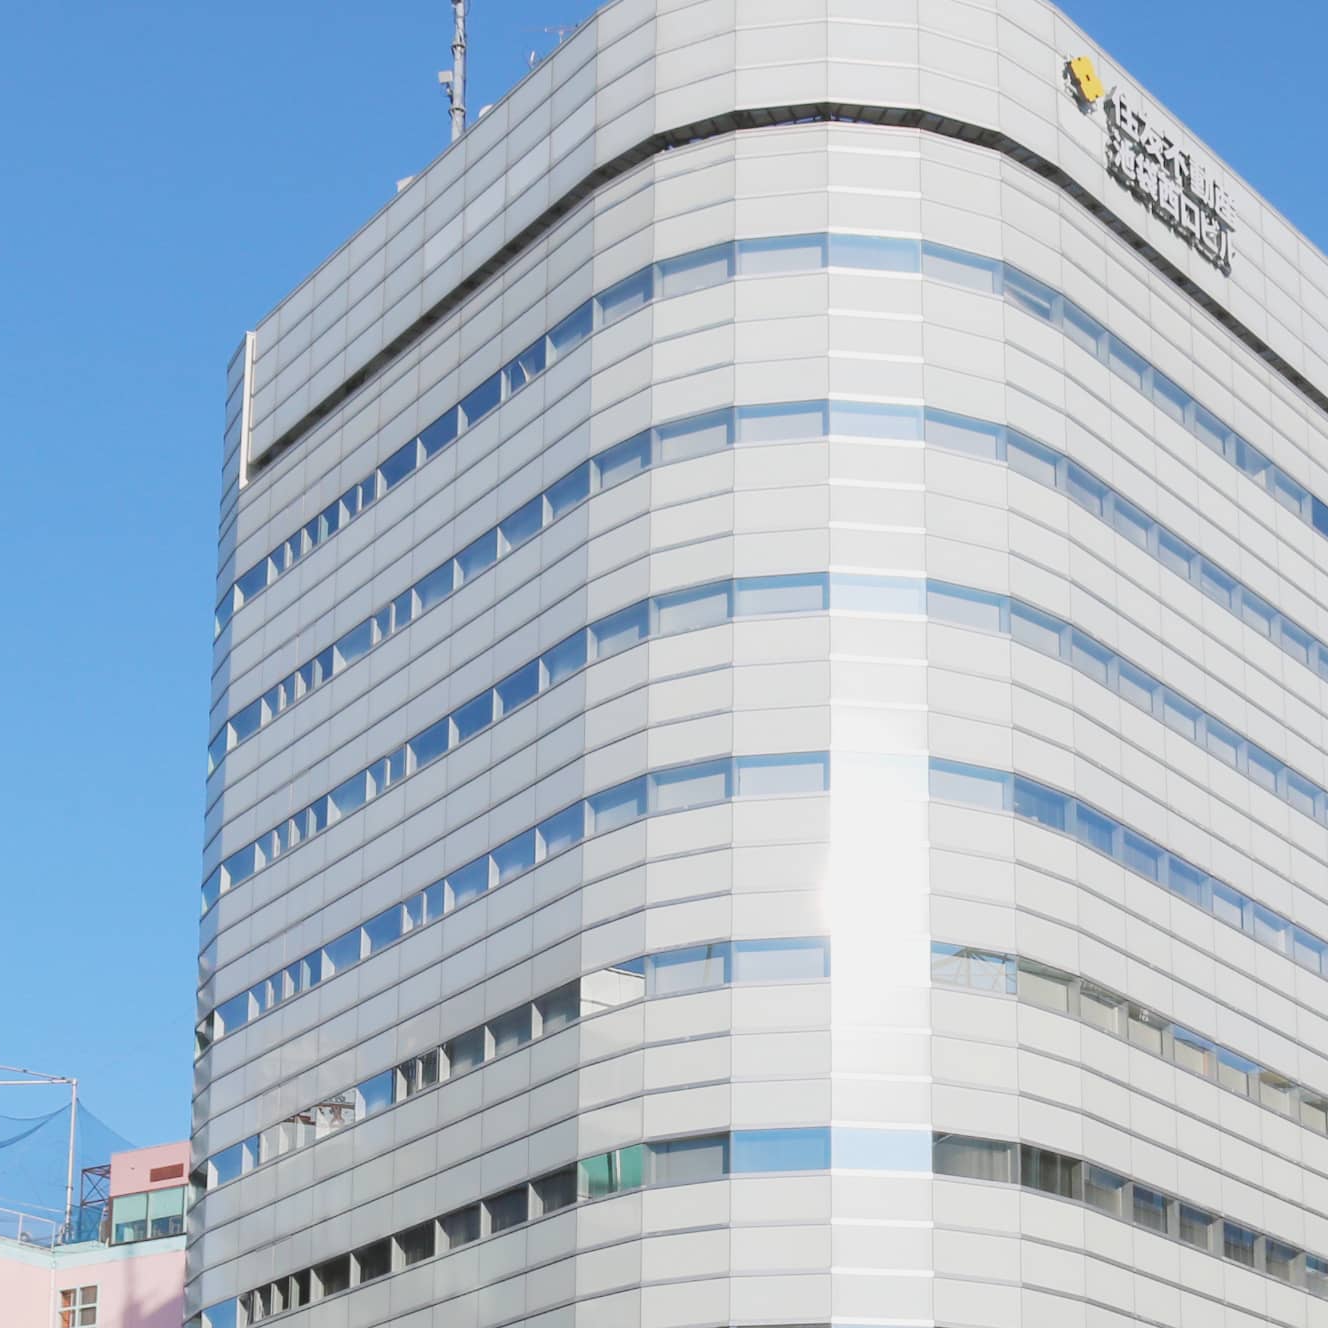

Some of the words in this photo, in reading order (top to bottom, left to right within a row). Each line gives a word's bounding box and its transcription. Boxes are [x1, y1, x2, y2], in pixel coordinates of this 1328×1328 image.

[1112, 130, 1236, 265] 池袋西口ビル
